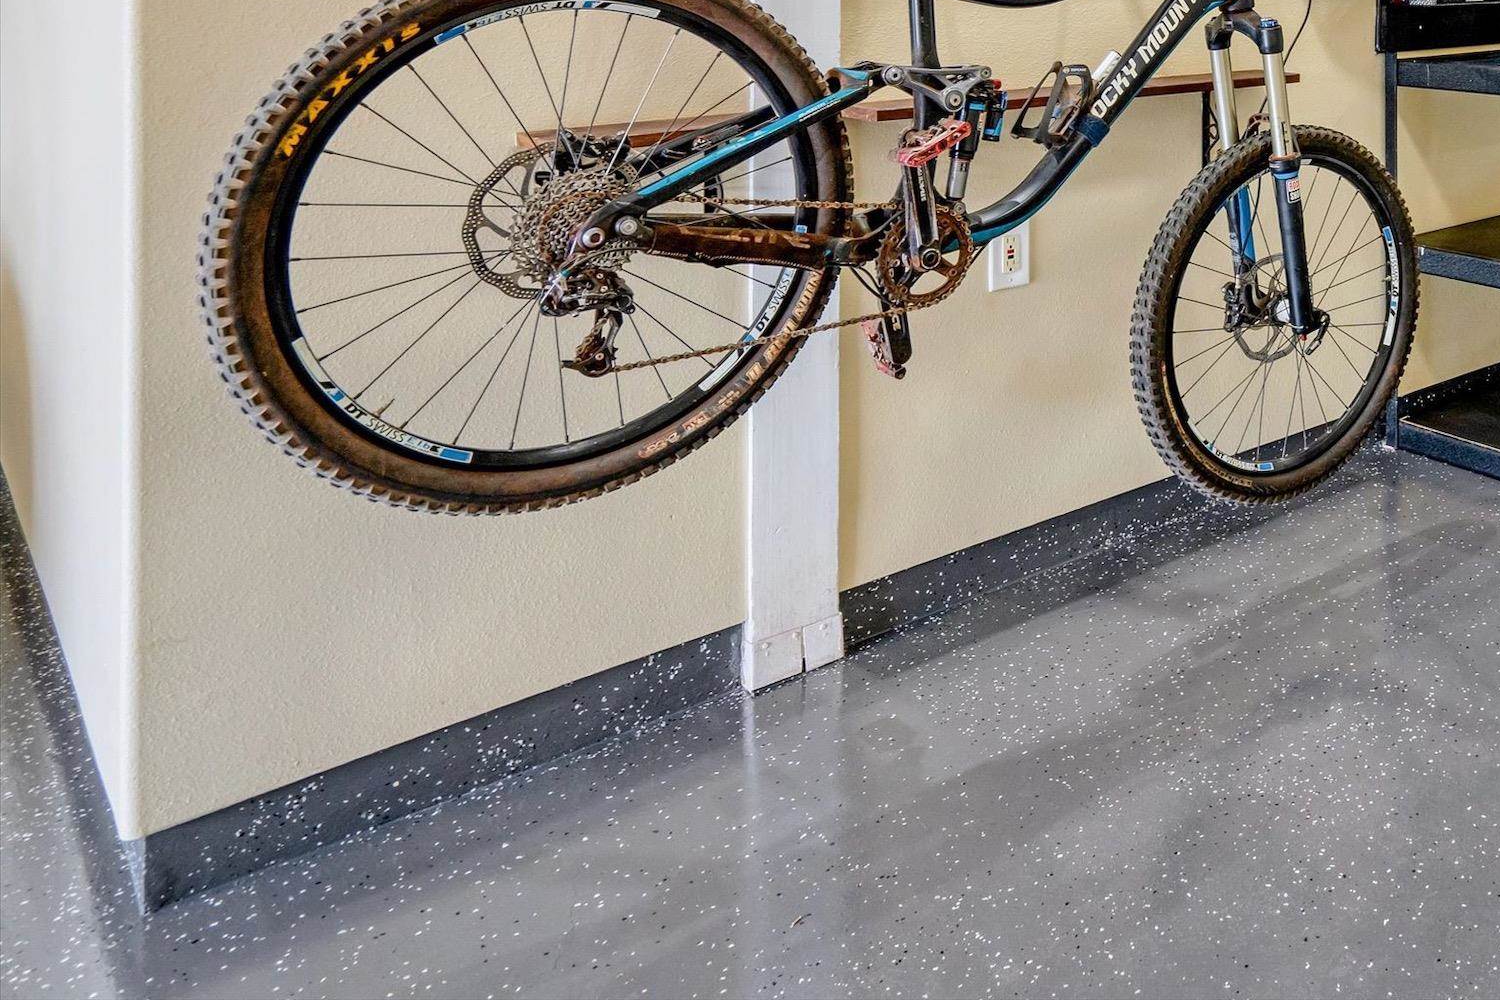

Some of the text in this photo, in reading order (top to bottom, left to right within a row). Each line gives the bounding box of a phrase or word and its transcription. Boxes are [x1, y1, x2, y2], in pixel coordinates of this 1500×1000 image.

[275, 23, 421, 157] MAXXIS
[1090, 58, 1138, 118] OCKY
[755, 313, 770, 332] DT
[769, 281, 791, 312] SWISS
[344, 403, 367, 420] DT
[366, 418, 406, 442] SWISS
